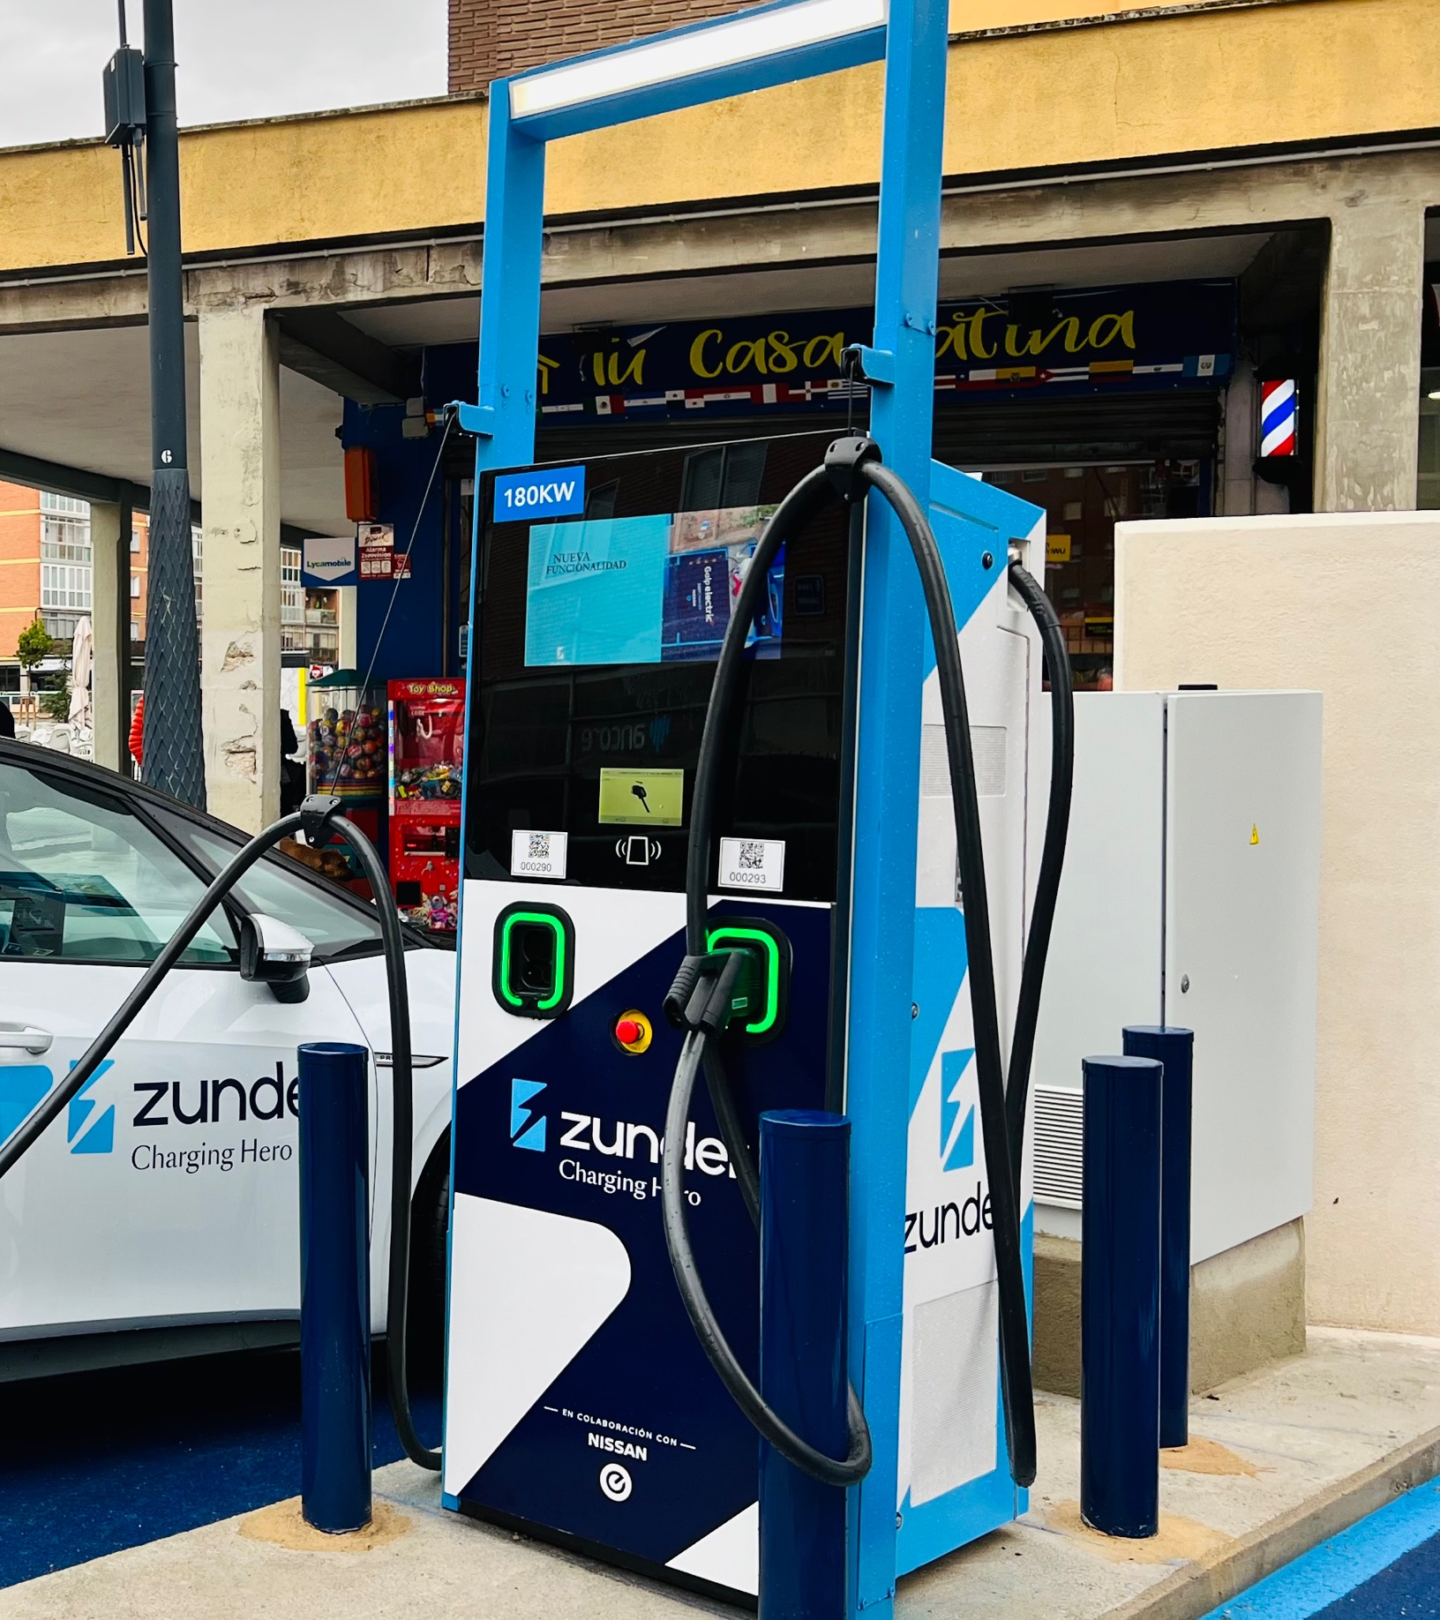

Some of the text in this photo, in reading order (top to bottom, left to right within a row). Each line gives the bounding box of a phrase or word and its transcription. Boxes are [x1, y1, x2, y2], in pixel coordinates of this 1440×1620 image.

[689, 329, 845, 379] Casa
[935, 307, 1136, 360] atina
[161, 449, 173, 464] 6
[503, 480, 576, 508] 180KW
[306, 557, 352, 569] Lycamobile
[546, 560, 627, 575] FUNCIONALIDAD
[553, 552, 591, 564] NUEVA
[408, 683, 453, 696] Toy Shop
[520, 861, 552, 873] 000290
[729, 872, 766, 884] 000293
[132, 1061, 300, 1127] zund
[131, 1138, 292, 1174] Charging Hero
[559, 1159, 701, 1206] Charging Ho
[903, 1181, 994, 1255] zunde
[562, 1408, 678, 1446] EN COLABORACIÓN CON
[587, 1432, 648, 1462] NISSAN
